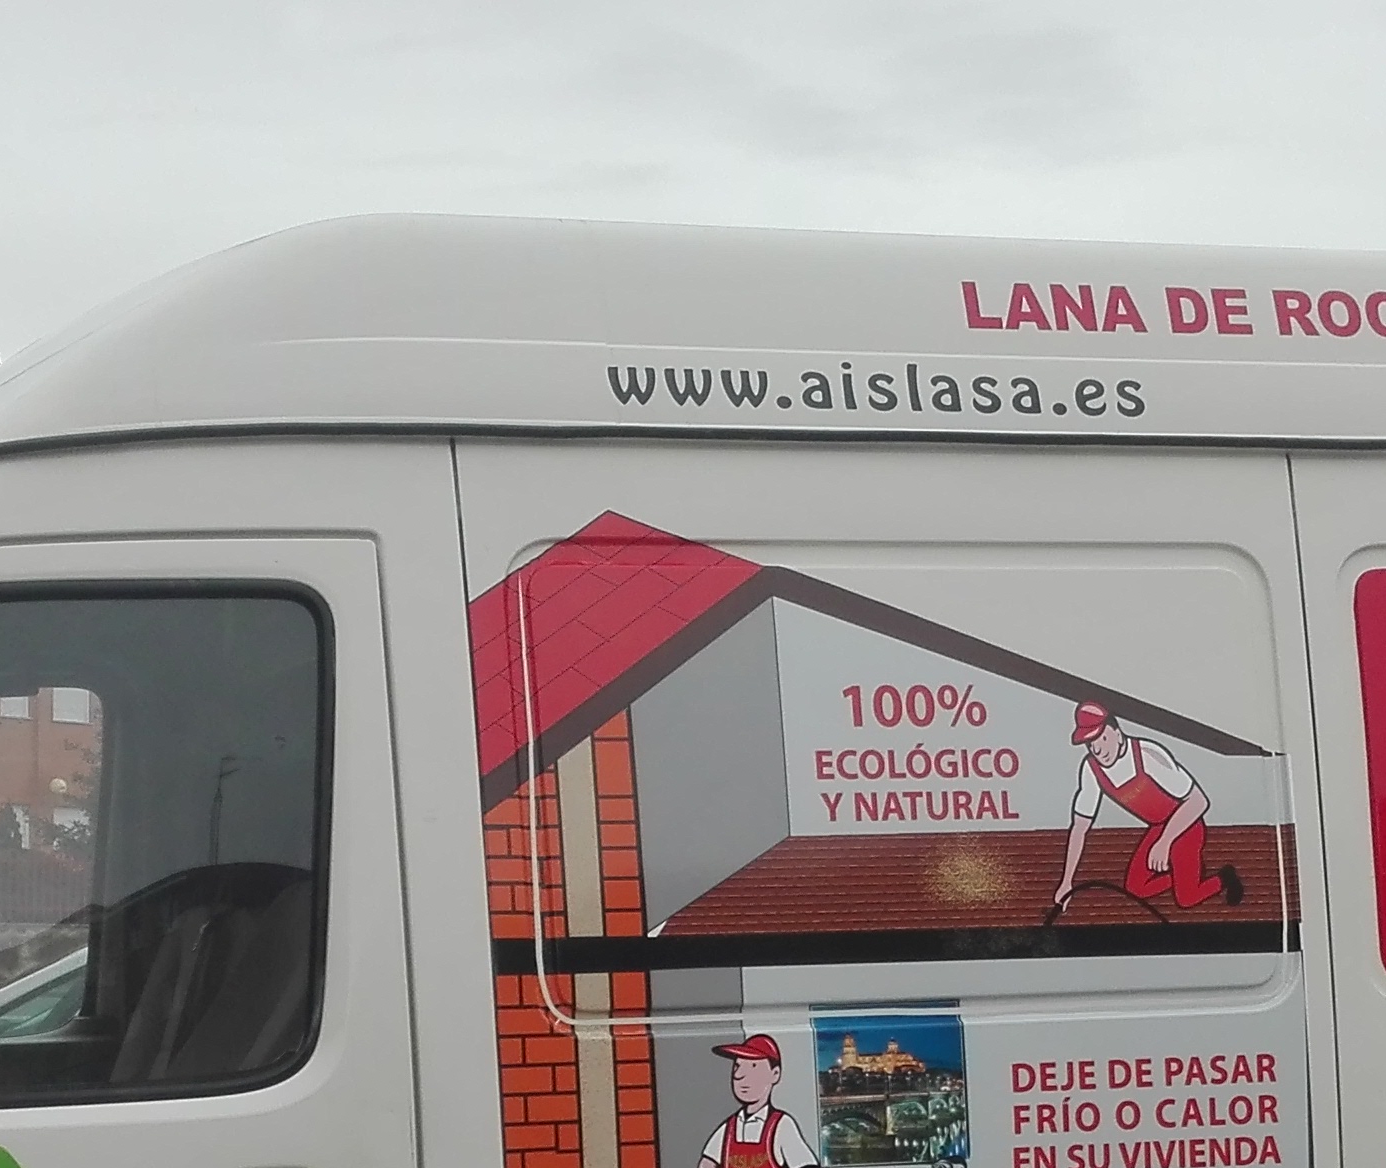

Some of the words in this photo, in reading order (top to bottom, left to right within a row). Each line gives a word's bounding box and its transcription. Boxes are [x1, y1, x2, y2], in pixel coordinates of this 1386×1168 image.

[962, 282, 1147, 333] LANA
[1165, 287, 1253, 335] DE
[608, 362, 1145, 417] www.aislasa.es
[843, 685, 987, 727] 100%
[816, 743, 1019, 780] ECOLÓGICO
[821, 793, 842, 821] Y
[854, 791, 1019, 821] NATURAL
[1012, 1061, 1096, 1092] DEJE
[1108, 1059, 1153, 1089] DE
[1165, 1054, 1276, 1086] PASAR
[1014, 1095, 1100, 1134] FRÍO
[1116, 1101, 1141, 1130] O
[1156, 1095, 1278, 1128] CALOR
